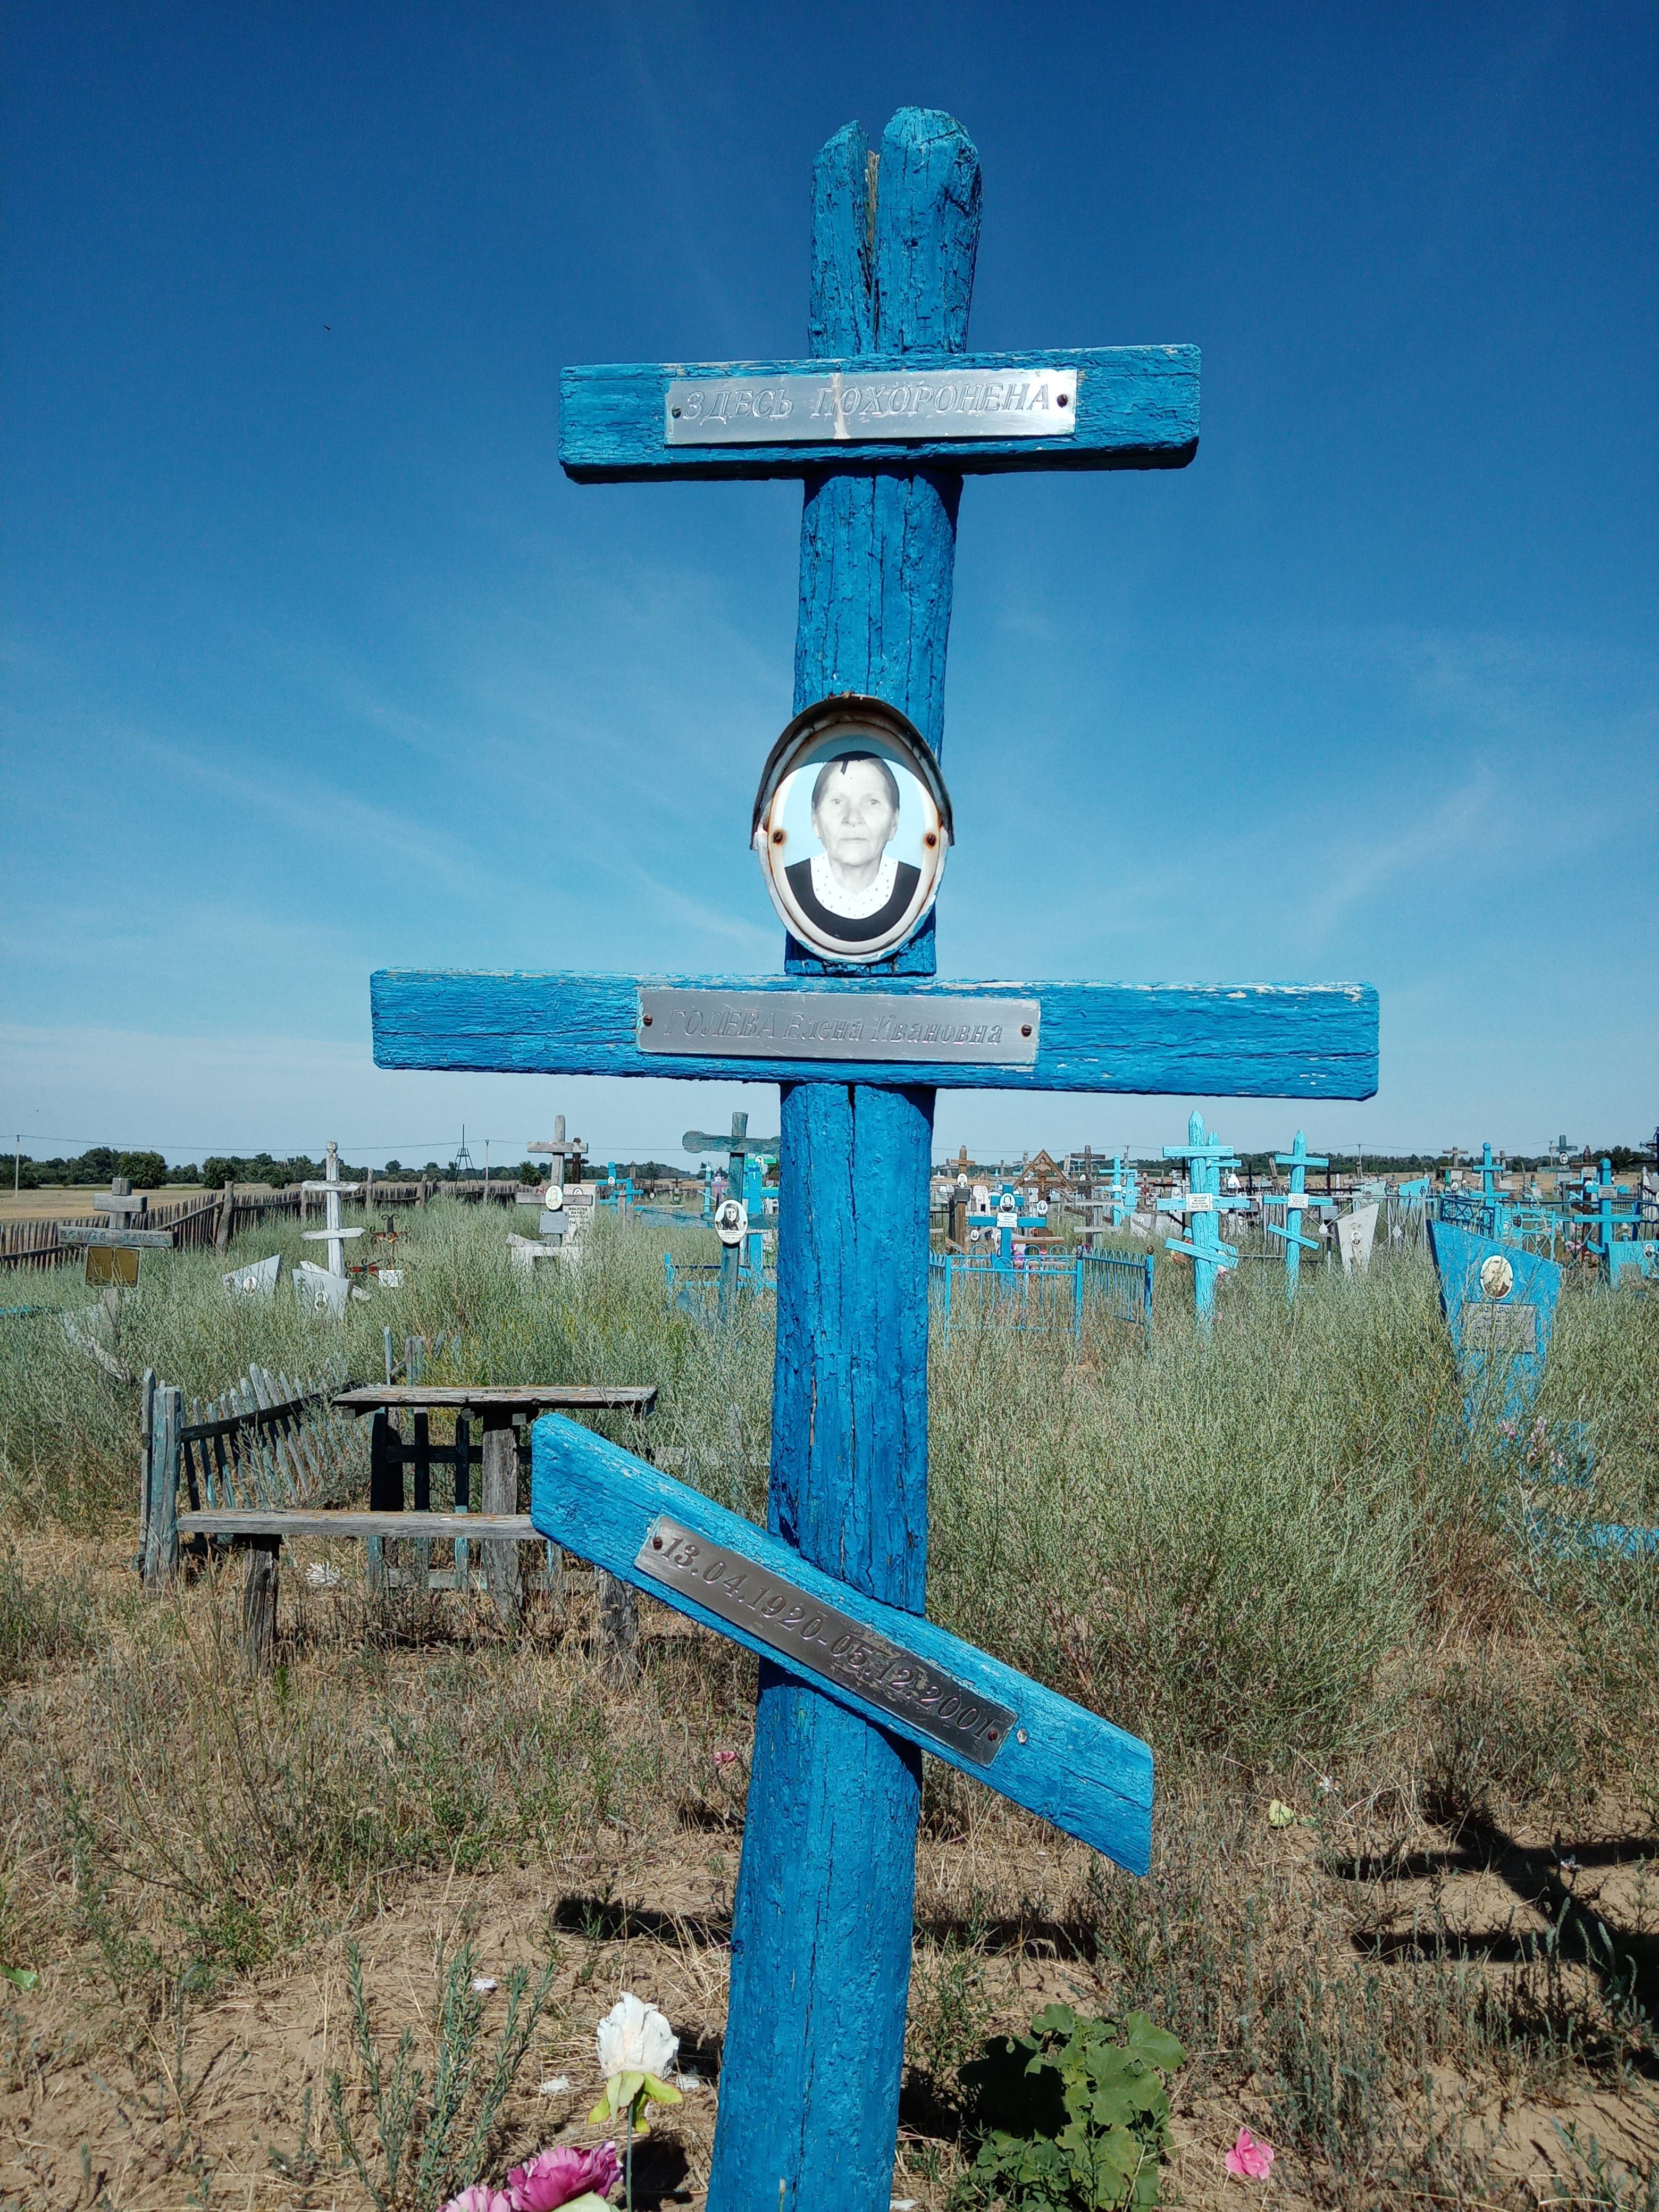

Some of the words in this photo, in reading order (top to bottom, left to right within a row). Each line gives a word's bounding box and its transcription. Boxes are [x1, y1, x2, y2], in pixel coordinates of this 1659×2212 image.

[683, 389, 793, 426] ЗДЕСЬ
[810, 383, 1050, 417] ПОХОРОНЕНА
[664, 1009, 776, 1038] ГОЛЕВА
[782, 1012, 864, 1042] Елена
[870, 1015, 1004, 1046] Ивановна
[661, 1537, 996, 1740] 13.04.1920-05.12.2001
